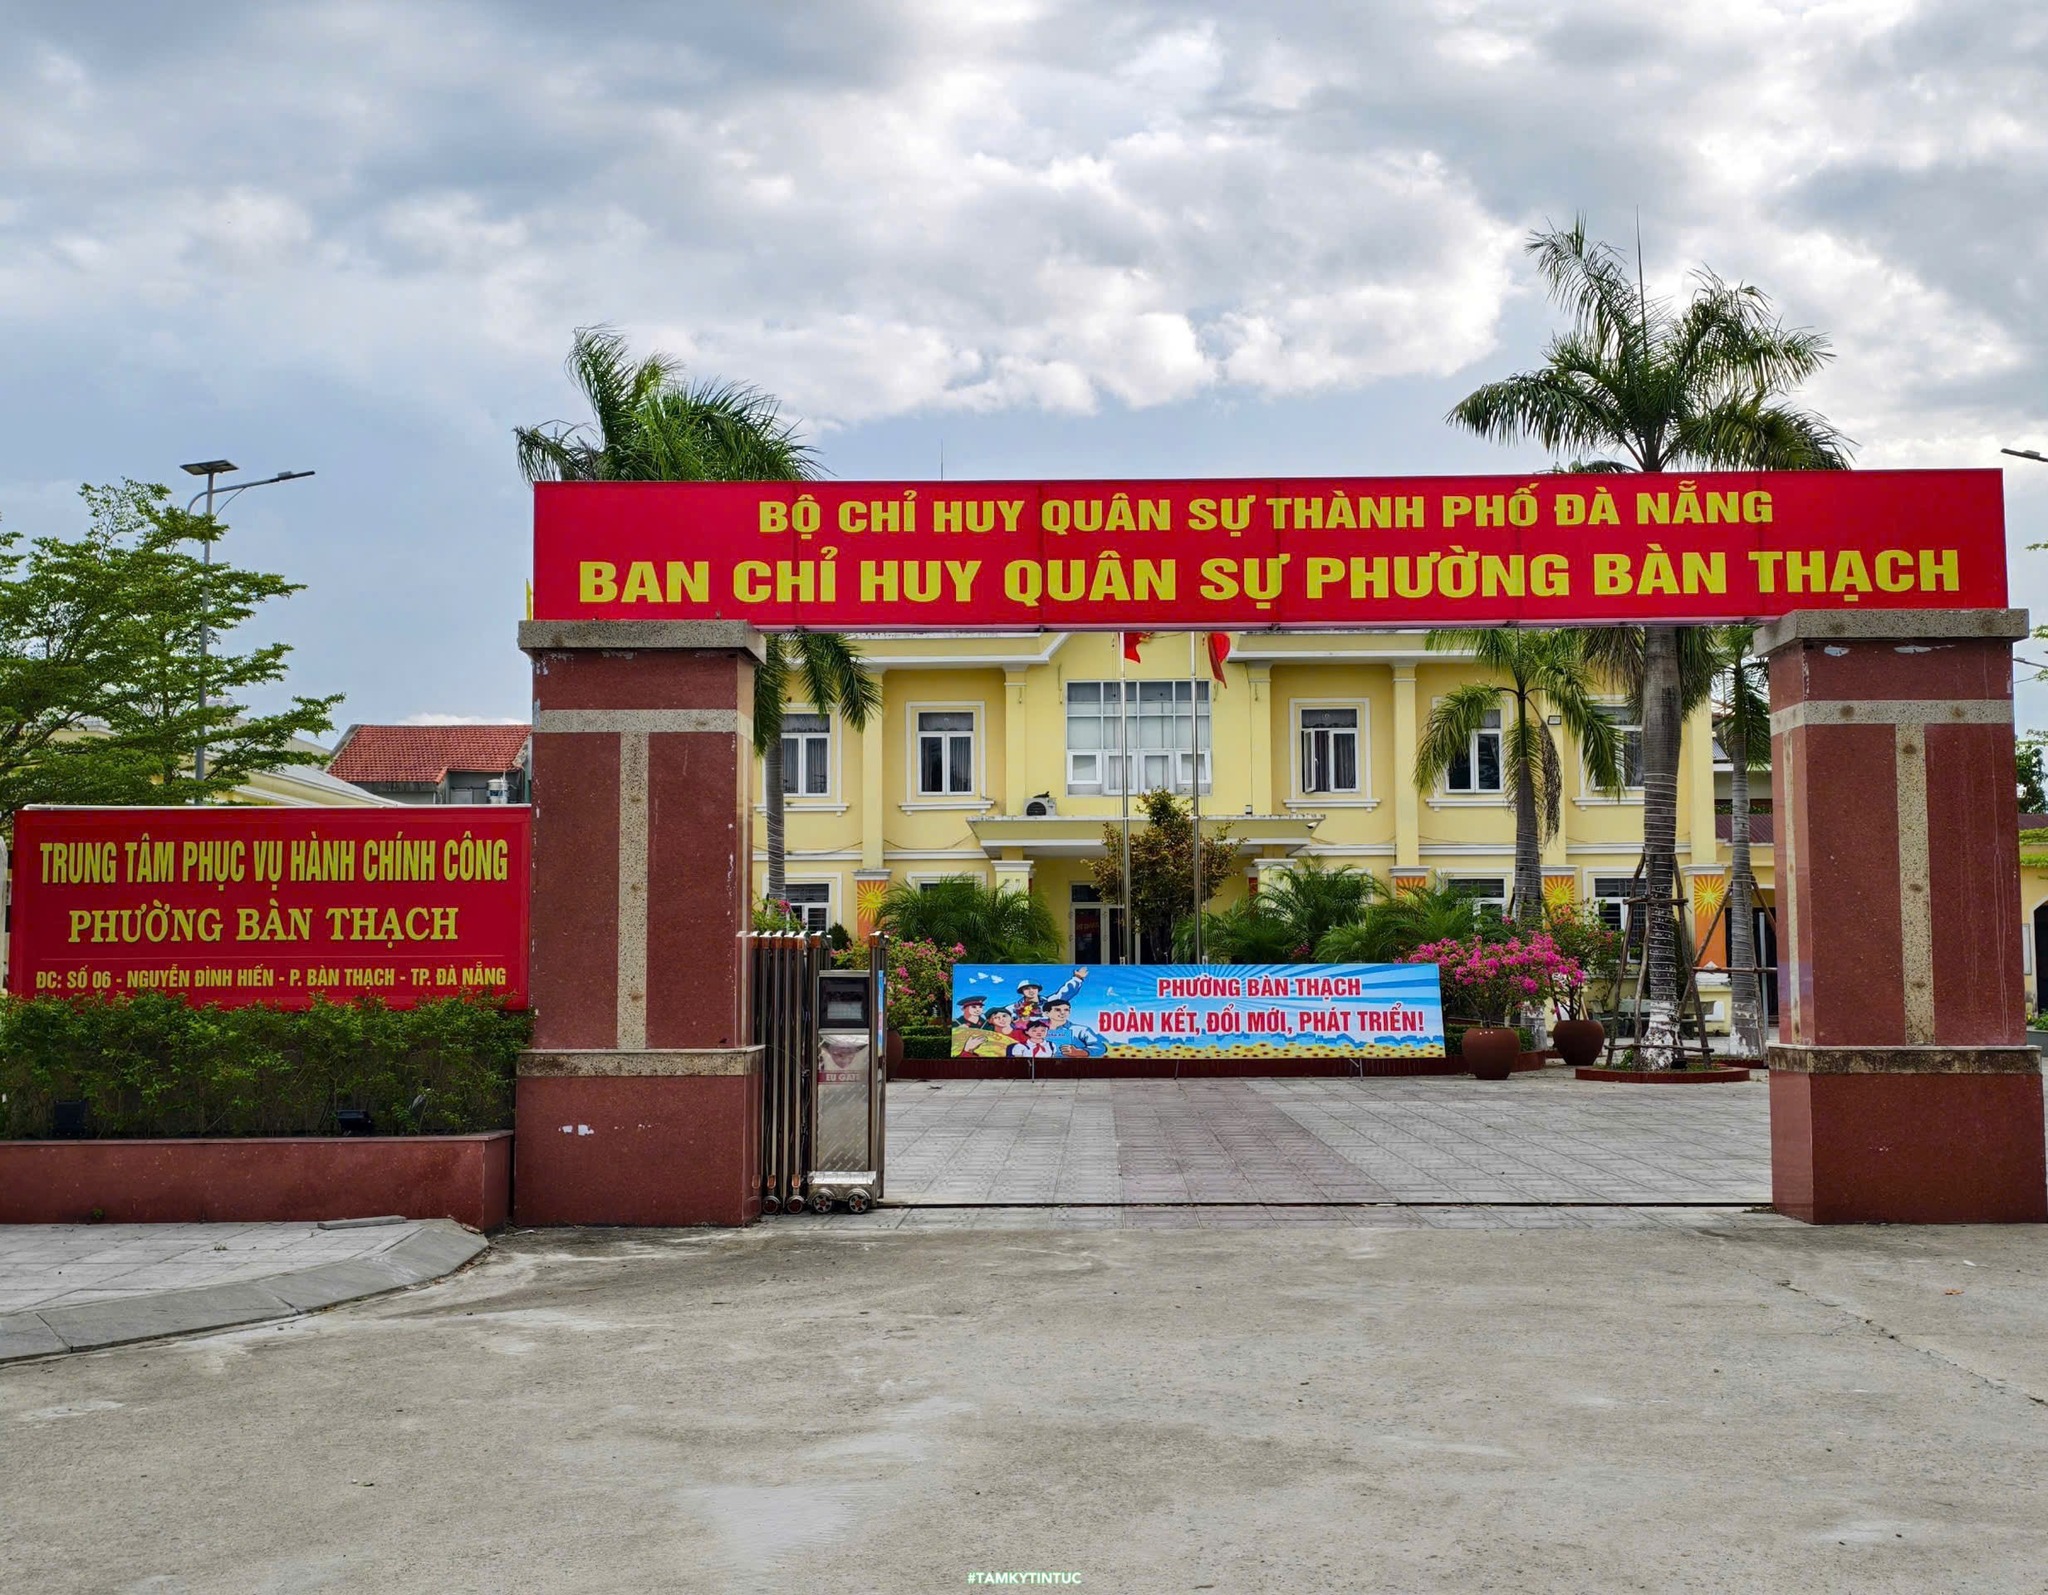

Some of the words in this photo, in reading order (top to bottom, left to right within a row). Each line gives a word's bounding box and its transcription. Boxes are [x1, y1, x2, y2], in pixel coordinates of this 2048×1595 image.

[759, 494, 821, 540] BỘ
[838, 490, 917, 533] CHỈ
[933, 500, 1024, 533] HUY
[1041, 492, 1171, 535] QUÂN
[1188, 494, 1256, 537] SỰ
[1266, 490, 1424, 529] THÀNH
[1442, 483, 1538, 528] PHỐ
[1554, 486, 1620, 526] ĐÀ
[1636, 482, 1773, 525] NẴNG
[579, 561, 709, 603] BAN
[733, 546, 838, 603] CHỈ
[860, 560, 981, 603] HUY
[1004, 550, 1176, 607] QUÂN
[1200, 553, 1291, 609] SỰ
[1306, 545, 1570, 599] PHƯỜNG
[1593, 543, 1727, 596] BÀN
[1748, 549, 1959, 602] THẠCH
[40, 842, 117, 884] TRUNG
[125, 833, 175, 883] TÂM
[182, 841, 245, 891] PHỤC
[253, 841, 283, 891] VỤ
[290, 831, 355, 881] HÀNH
[363, 831, 436, 882] CHÍNH
[443, 831, 508, 881] CÔNG
[68, 900, 223, 943] PHƯỜNG
[236, 899, 313, 941] BÀN
[326, 907, 459, 948] THẠCH
[36, 971, 62, 989] ĐC:
[66, 965, 88, 989] SỐ
[92, 971, 111, 988] 06
[127, 964, 190, 988] NGUYỄN
[194, 966, 232, 987] ĐÌNH
[289, 968, 302, 987] P.
[307, 965, 340, 986] BÀN
[344, 968, 395, 990] THẠCH
[411, 968, 431, 986] TP.
[435, 965, 457, 985] ĐÀ
[462, 961, 506, 985] NẴNG
[1158, 975, 1241, 997] PHƯỜNG
[1247, 975, 1289, 997] BÀN
[1294, 978, 1361, 1000] THẠCH
[1098, 1007, 1154, 1033] ĐOÀN
[1161, 1005, 1200, 1036] KẾT,
[1206, 1003, 1240, 1032] ĐỔI
[1247, 1007, 1293, 1035] MỚI,
[1299, 1007, 1352, 1032] PHÁT
[1357, 1002, 1424, 1032] TRIỂN!
